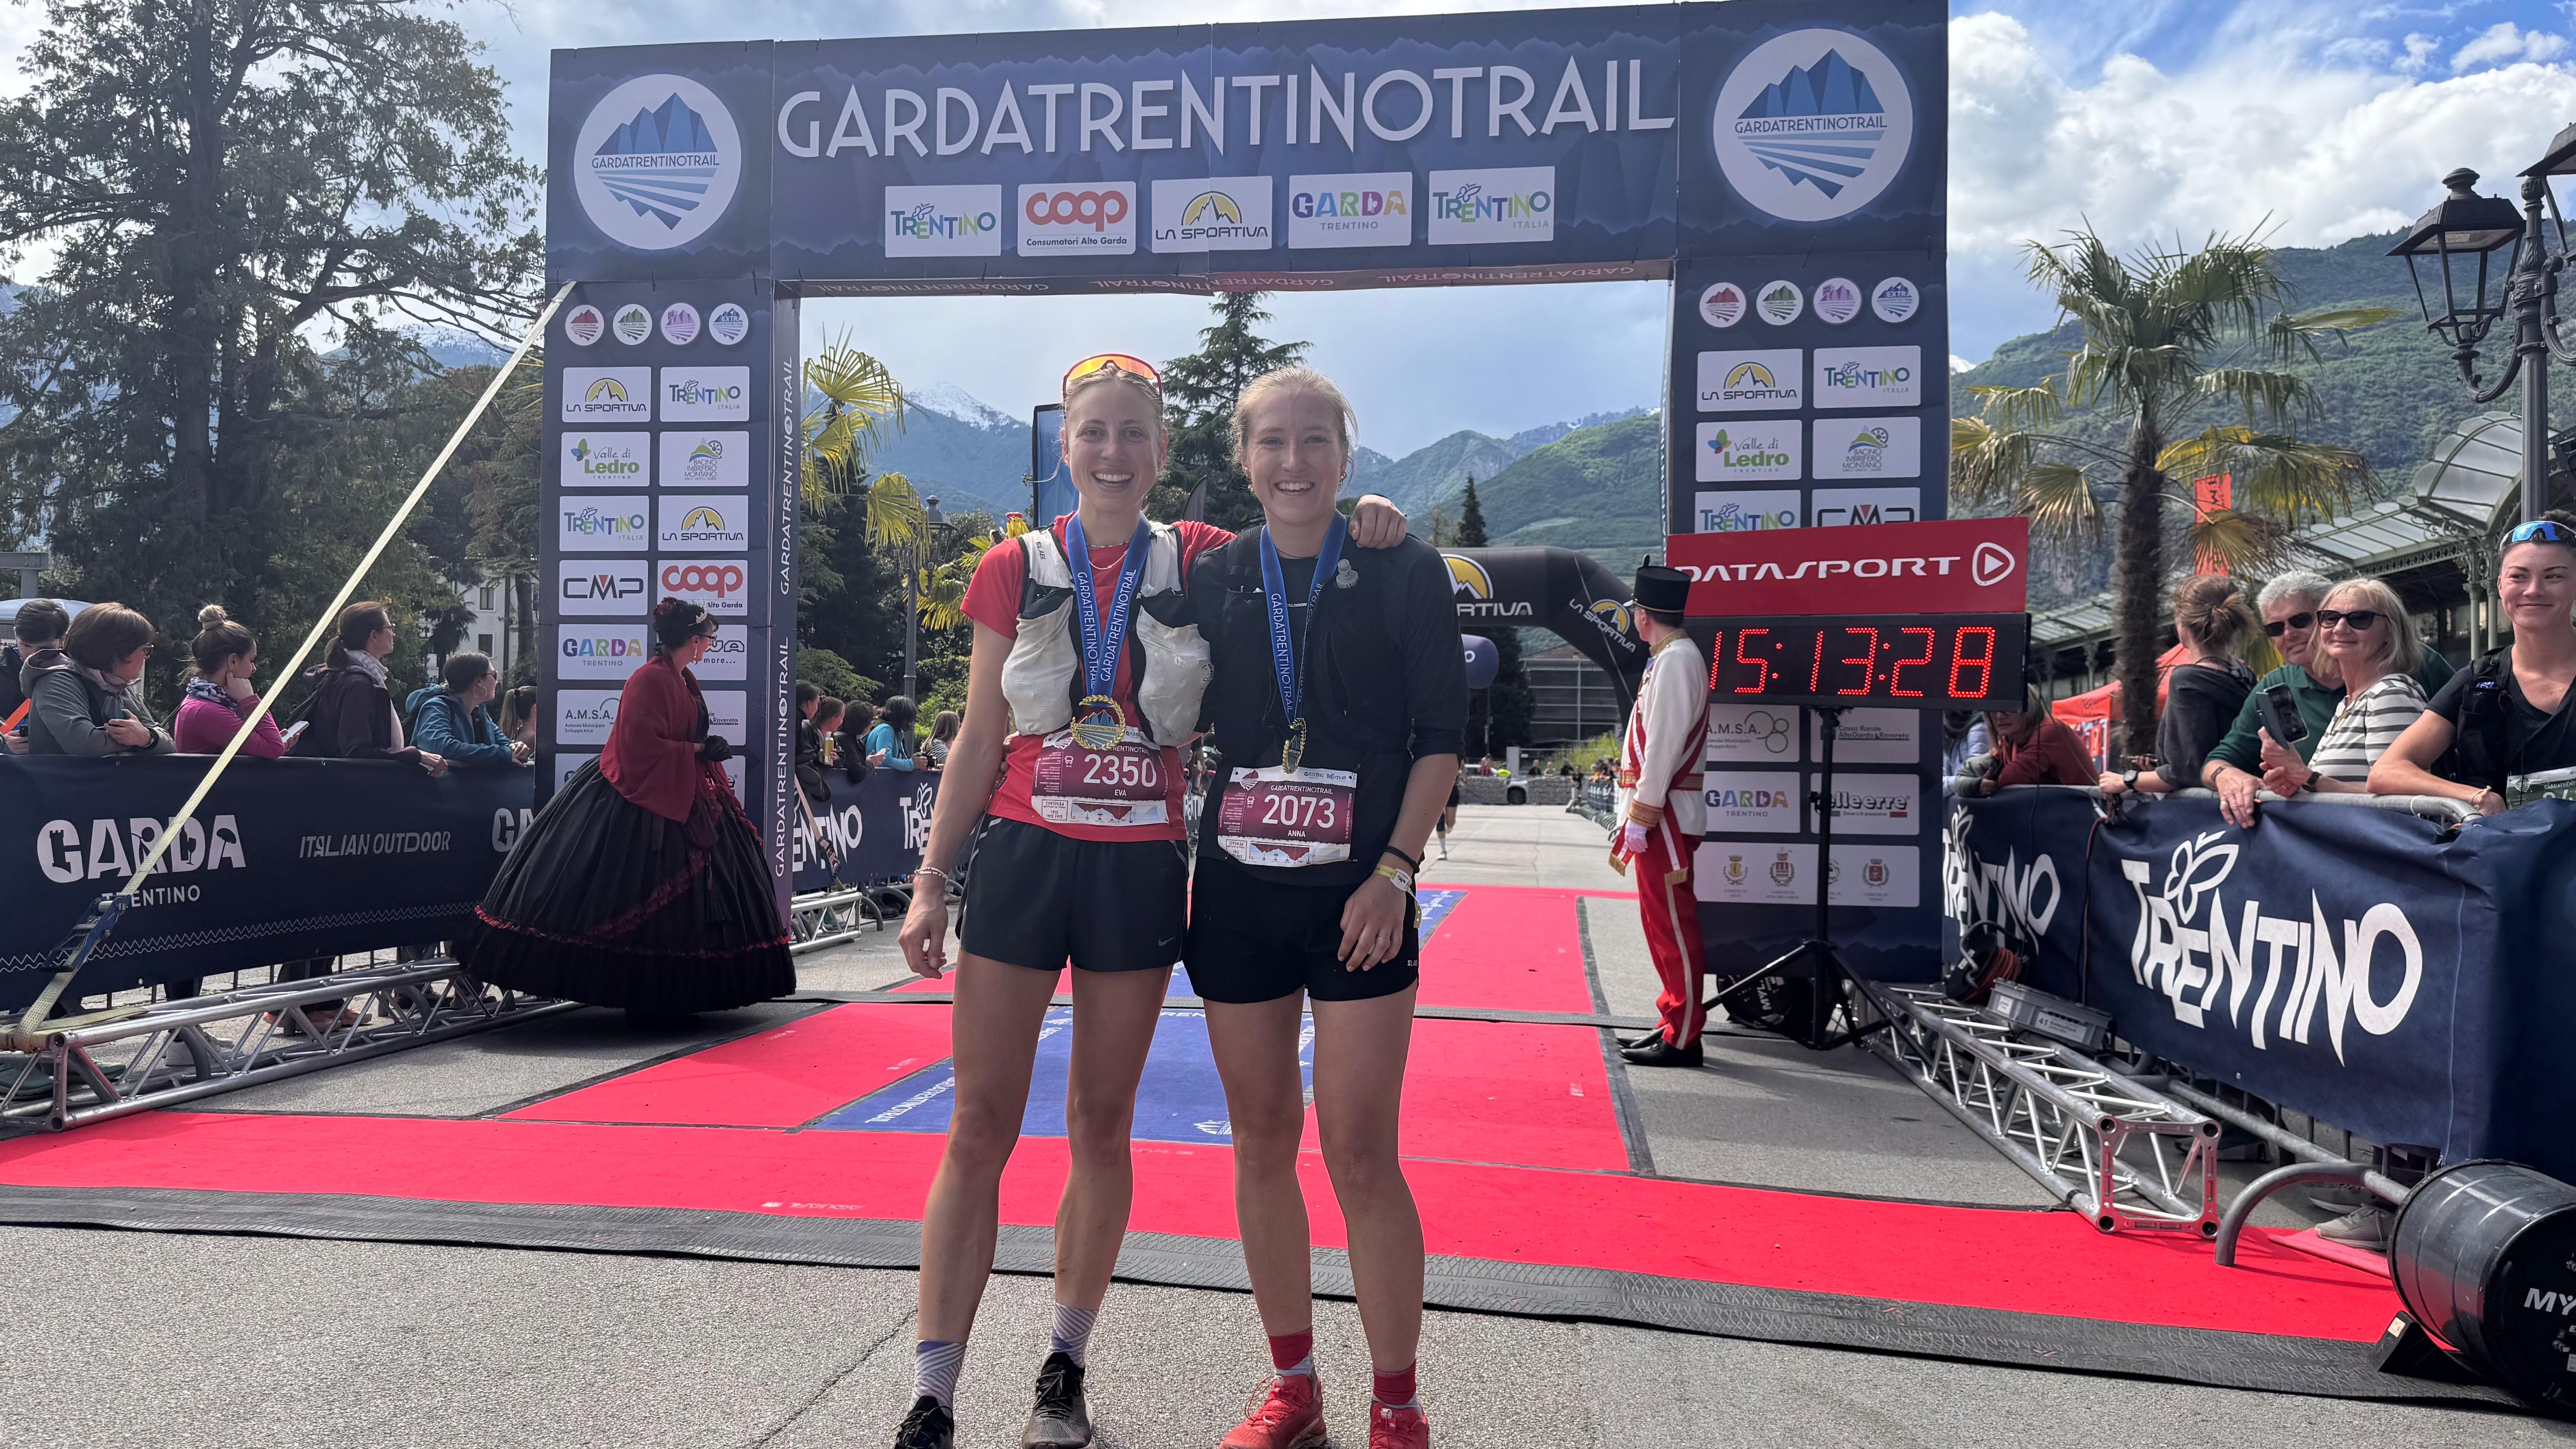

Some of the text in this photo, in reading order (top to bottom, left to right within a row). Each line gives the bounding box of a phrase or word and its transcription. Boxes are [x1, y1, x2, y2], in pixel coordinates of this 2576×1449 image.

[778, 55, 1675, 158] GARDATRENTINOTRAIL
[1735, 116, 1888, 133] GARDATRENTINOTRAIL
[591, 153, 719, 169] GARDATRENTINOTRAIL
[1292, 190, 1407, 218] GARDA
[1432, 191, 1551, 222] TRENTINO
[890, 210, 996, 239] TRENTINO
[1156, 226, 1268, 239] LA SPORTIVA
[1320, 221, 1379, 230] TRENTINO
[1513, 220, 1549, 228] ITALIA
[1026, 235, 1127, 246] Consumatori Alto Garda
[1378, 267, 1635, 282] GARDATRENTINOTRAIL
[809, 283, 1050, 294] GARDATRENTINOTRAIL
[1824, 367, 1910, 389] TRENTINO
[669, 384, 741, 405] TRENTINO
[1702, 389, 1797, 400] LA SPORTIVA
[567, 404, 647, 412] LA SPORTIVA
[593, 446, 631, 459] Valle di
[1734, 437, 1779, 451] Valle di
[585, 459, 639, 473] Ledro
[1724, 450, 1789, 467] Ledro
[780, 355, 793, 596] GARDATRENTINOTRAIL
[564, 512, 645, 535] TRENTINO
[1700, 509, 1795, 532] TRENTINO
[662, 533, 744, 541] LA SPORTIVA
[1674, 556, 1961, 583] DATASPORT
[563, 574, 644, 601] CMP
[1457, 602, 1533, 616] RTIVA
[1101, 569, 1137, 681] GARDATRENTINOTRAIL
[1569, 598, 1636, 653] LA SPORTIVA
[562, 637, 643, 657] GARDA
[1271, 593, 1293, 713] GARDATRENTINOTRAIL
[1710, 627, 1996, 698] 15:13:28
[565, 709, 614, 719] A.M.S.A.
[1706, 723, 1761, 735] A.M.S.A.
[775, 637, 789, 877] GARDATRENTINOTRAIL
[1083, 754, 1157, 787] 2350
[1270, 785, 1333, 794] GARDATRENTINOTRAIL
[1705, 790, 1789, 808] GARDA
[1831, 790, 1907, 810] lleerre
[1262, 794, 1335, 829] 2073
[299, 831, 451, 858] ITALIAN OUTDOOR
[792, 803, 862, 872] ENTINO
[37, 815, 247, 883] GARDA
[102, 884, 200, 908] TENTINO
[2121, 859, 2423, 1067] TRENTINO
